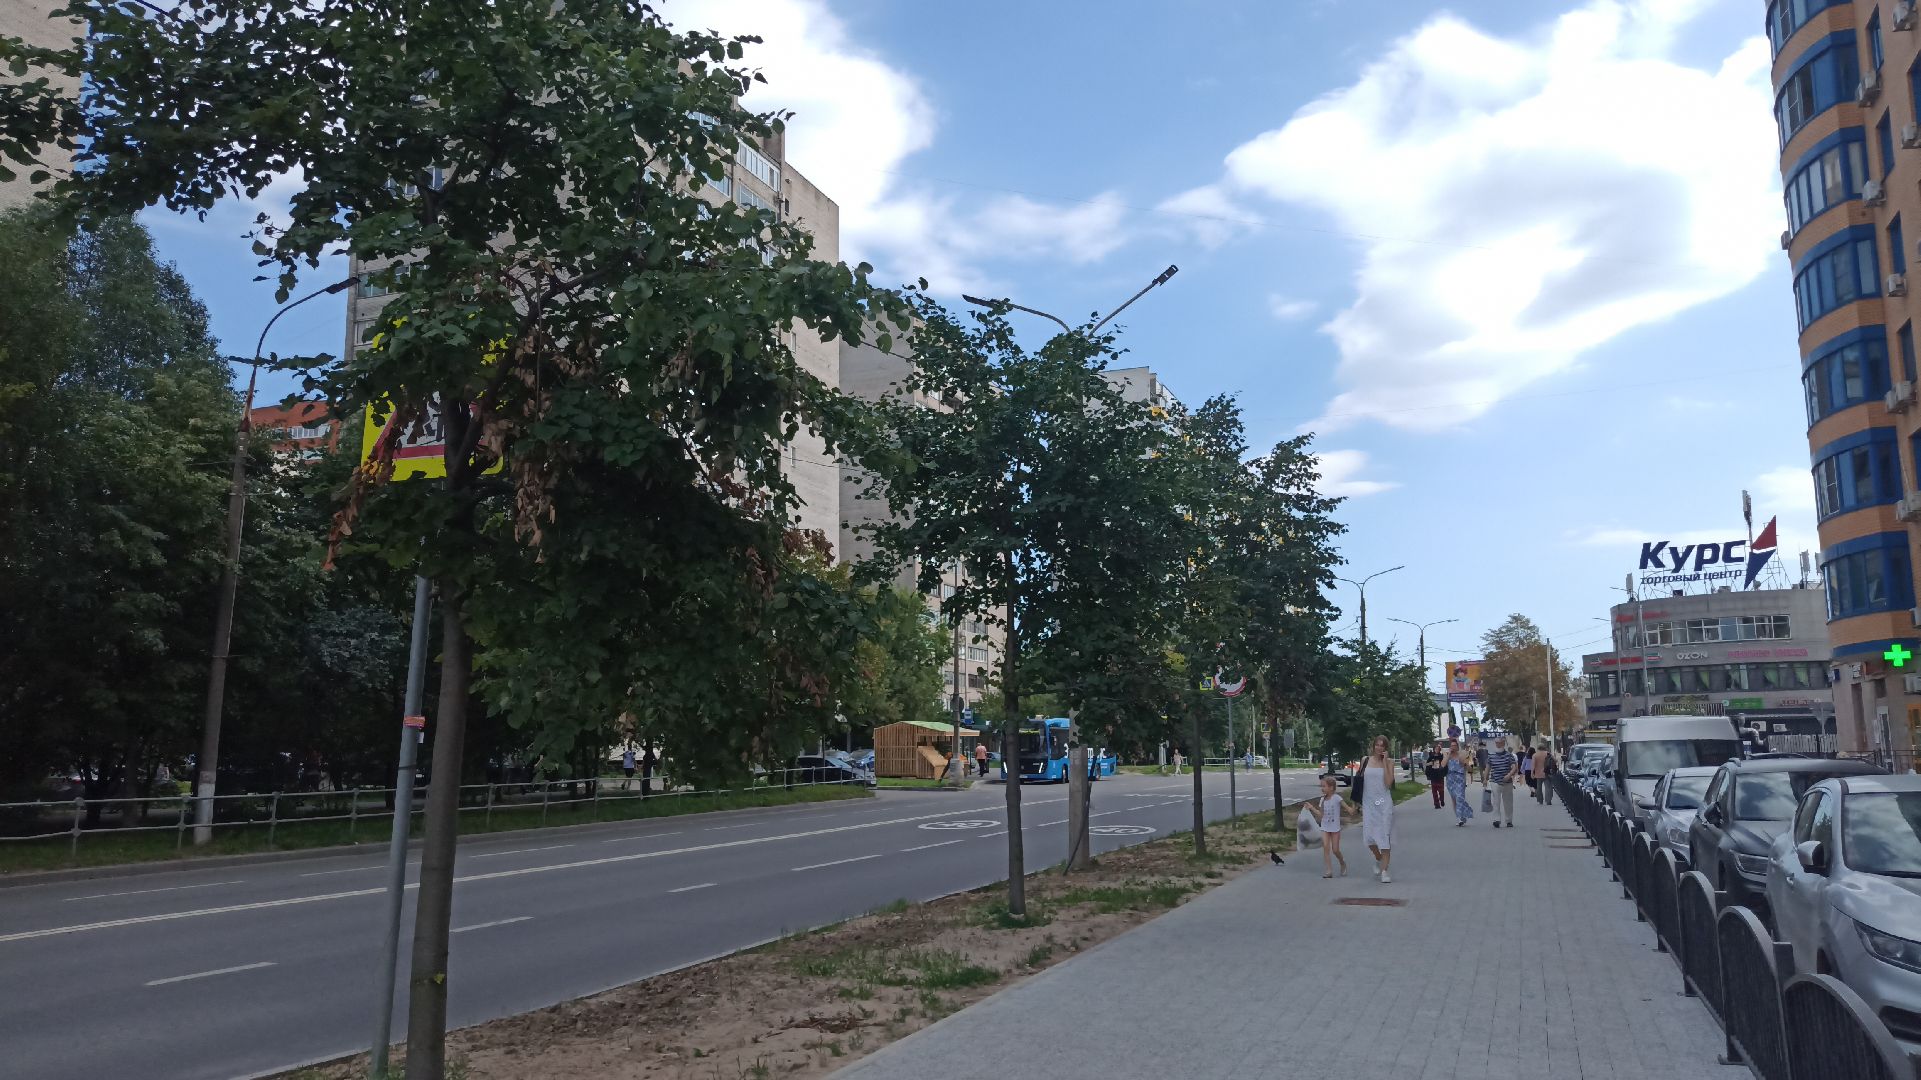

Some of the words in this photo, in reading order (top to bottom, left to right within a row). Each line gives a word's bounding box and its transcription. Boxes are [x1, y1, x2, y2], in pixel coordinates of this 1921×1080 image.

[1638, 540, 1747, 574] Курс
[1640, 572, 1700, 586] торговый
[1704, 569, 1742, 581] центр
[1676, 651, 1708, 660] OZON
